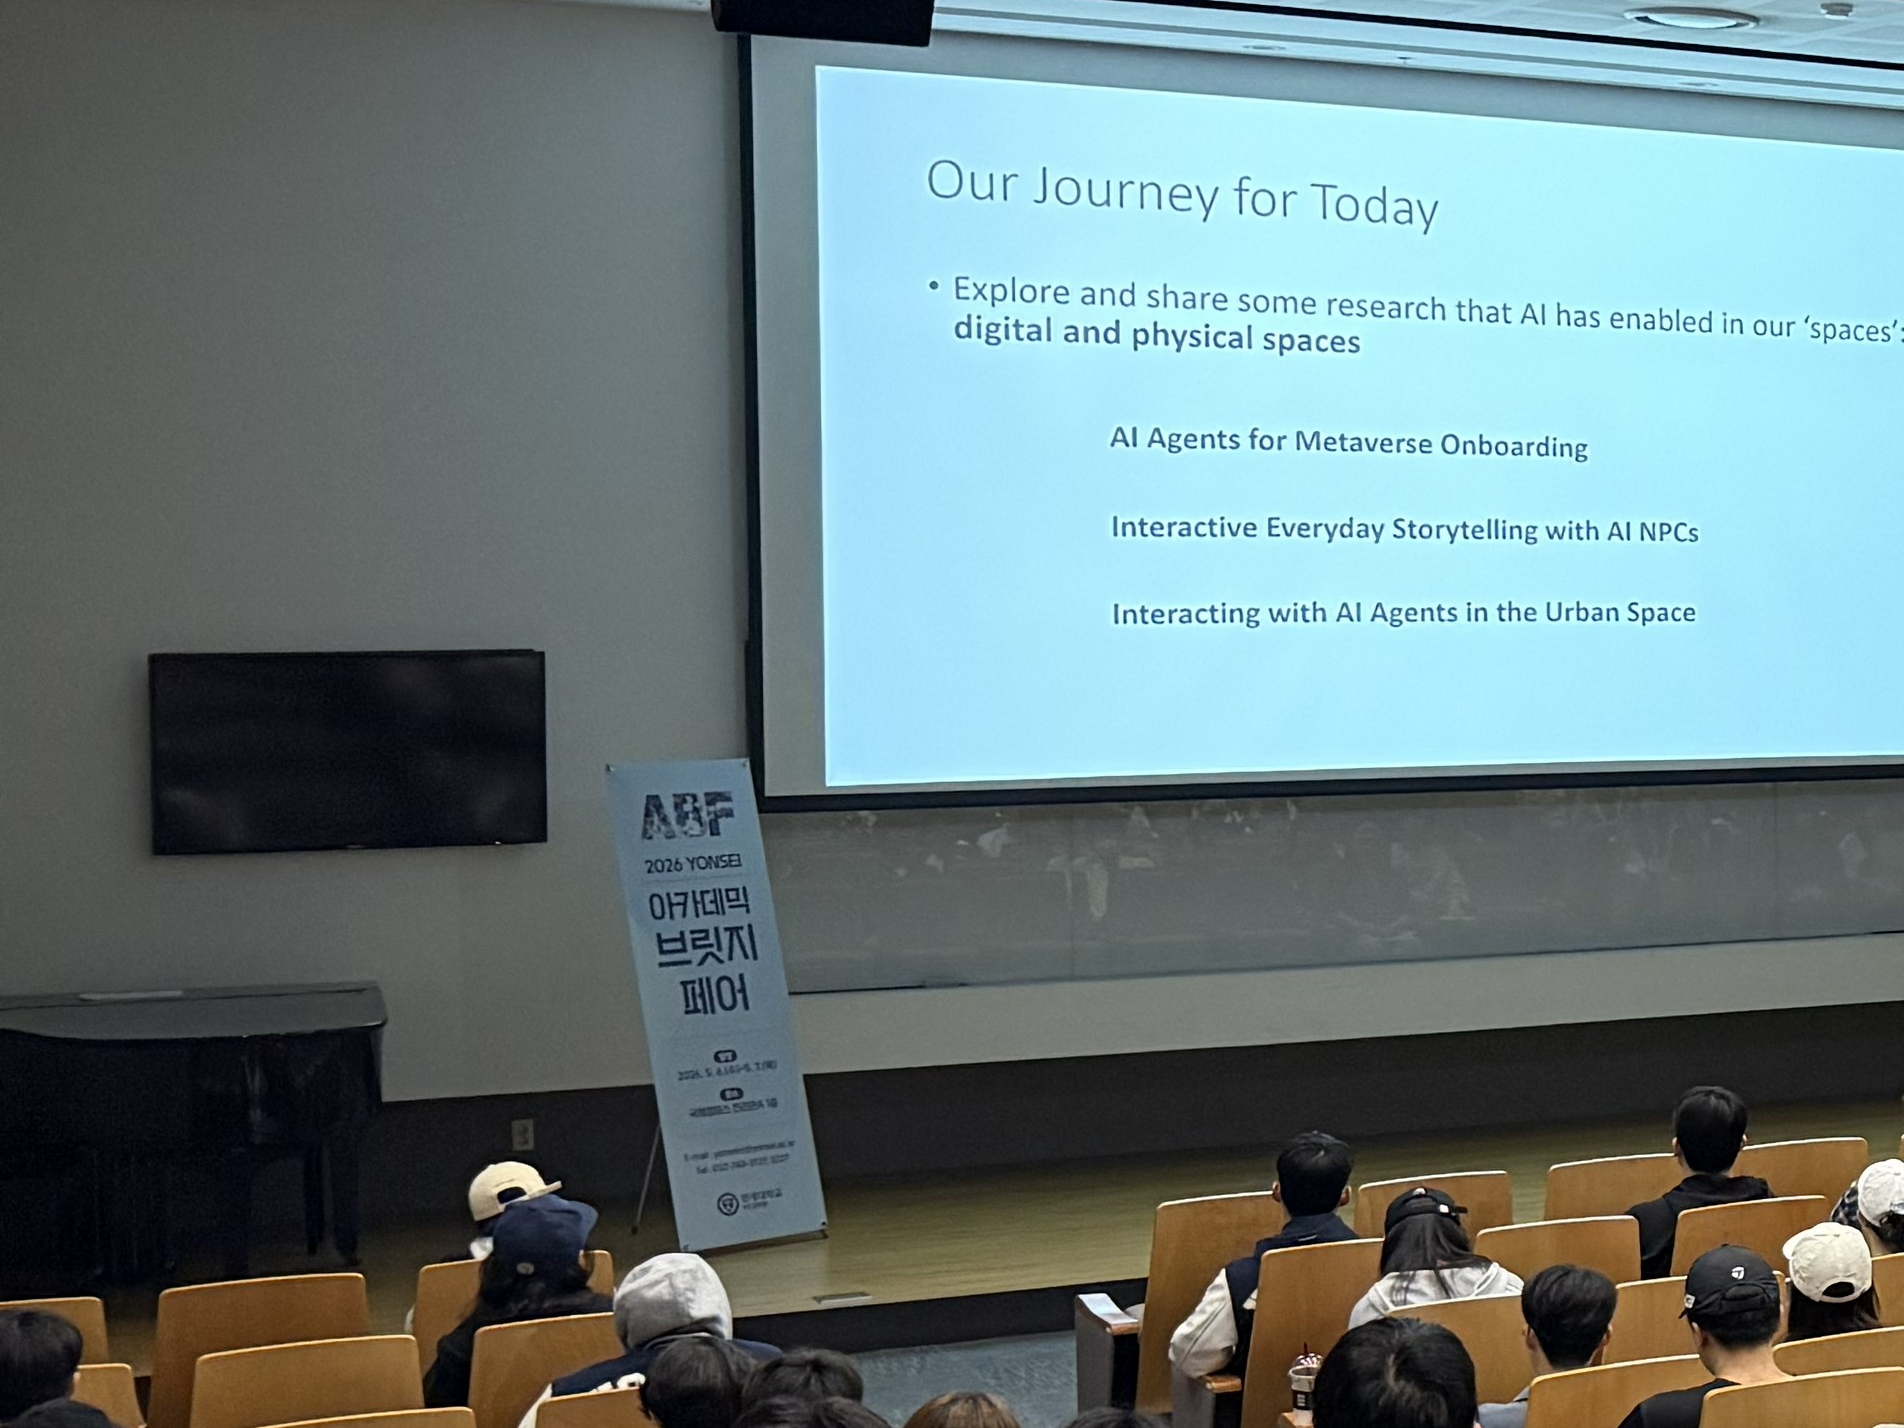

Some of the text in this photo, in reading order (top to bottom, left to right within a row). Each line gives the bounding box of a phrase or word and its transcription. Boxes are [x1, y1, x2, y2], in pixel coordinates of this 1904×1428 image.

[927, 159, 1439, 236] Our Journey for Today
[955, 276, 1070, 312] Explore
[1080, 281, 1136, 308] and
[1147, 282, 1229, 312] share
[1238, 293, 1317, 316] some
[1327, 295, 1446, 321] research
[1455, 297, 1512, 325] that
[1520, 302, 1546, 326] AI
[1556, 301, 1601, 329] has
[1609, 307, 1713, 334] enabled
[1722, 311, 1744, 335] in
[1753, 319, 1796, 338] our
[954, 313, 1361, 359] digital and physical spaces
[1110, 426, 1588, 463] AI Agents for Metaverse Onboarding
[1112, 515, 1699, 546] Interactive Everyday Storytelling with AI NPCs
[1113, 600, 1696, 629] Interacting with AI Agents in the Urban Space
[641, 790, 736, 840] ABF
[645, 853, 743, 874] 2026 YONSEI
[648, 886, 751, 921] 아카데믹
[656, 922, 759, 968] 브릿지
[680, 973, 751, 1016] 페어
